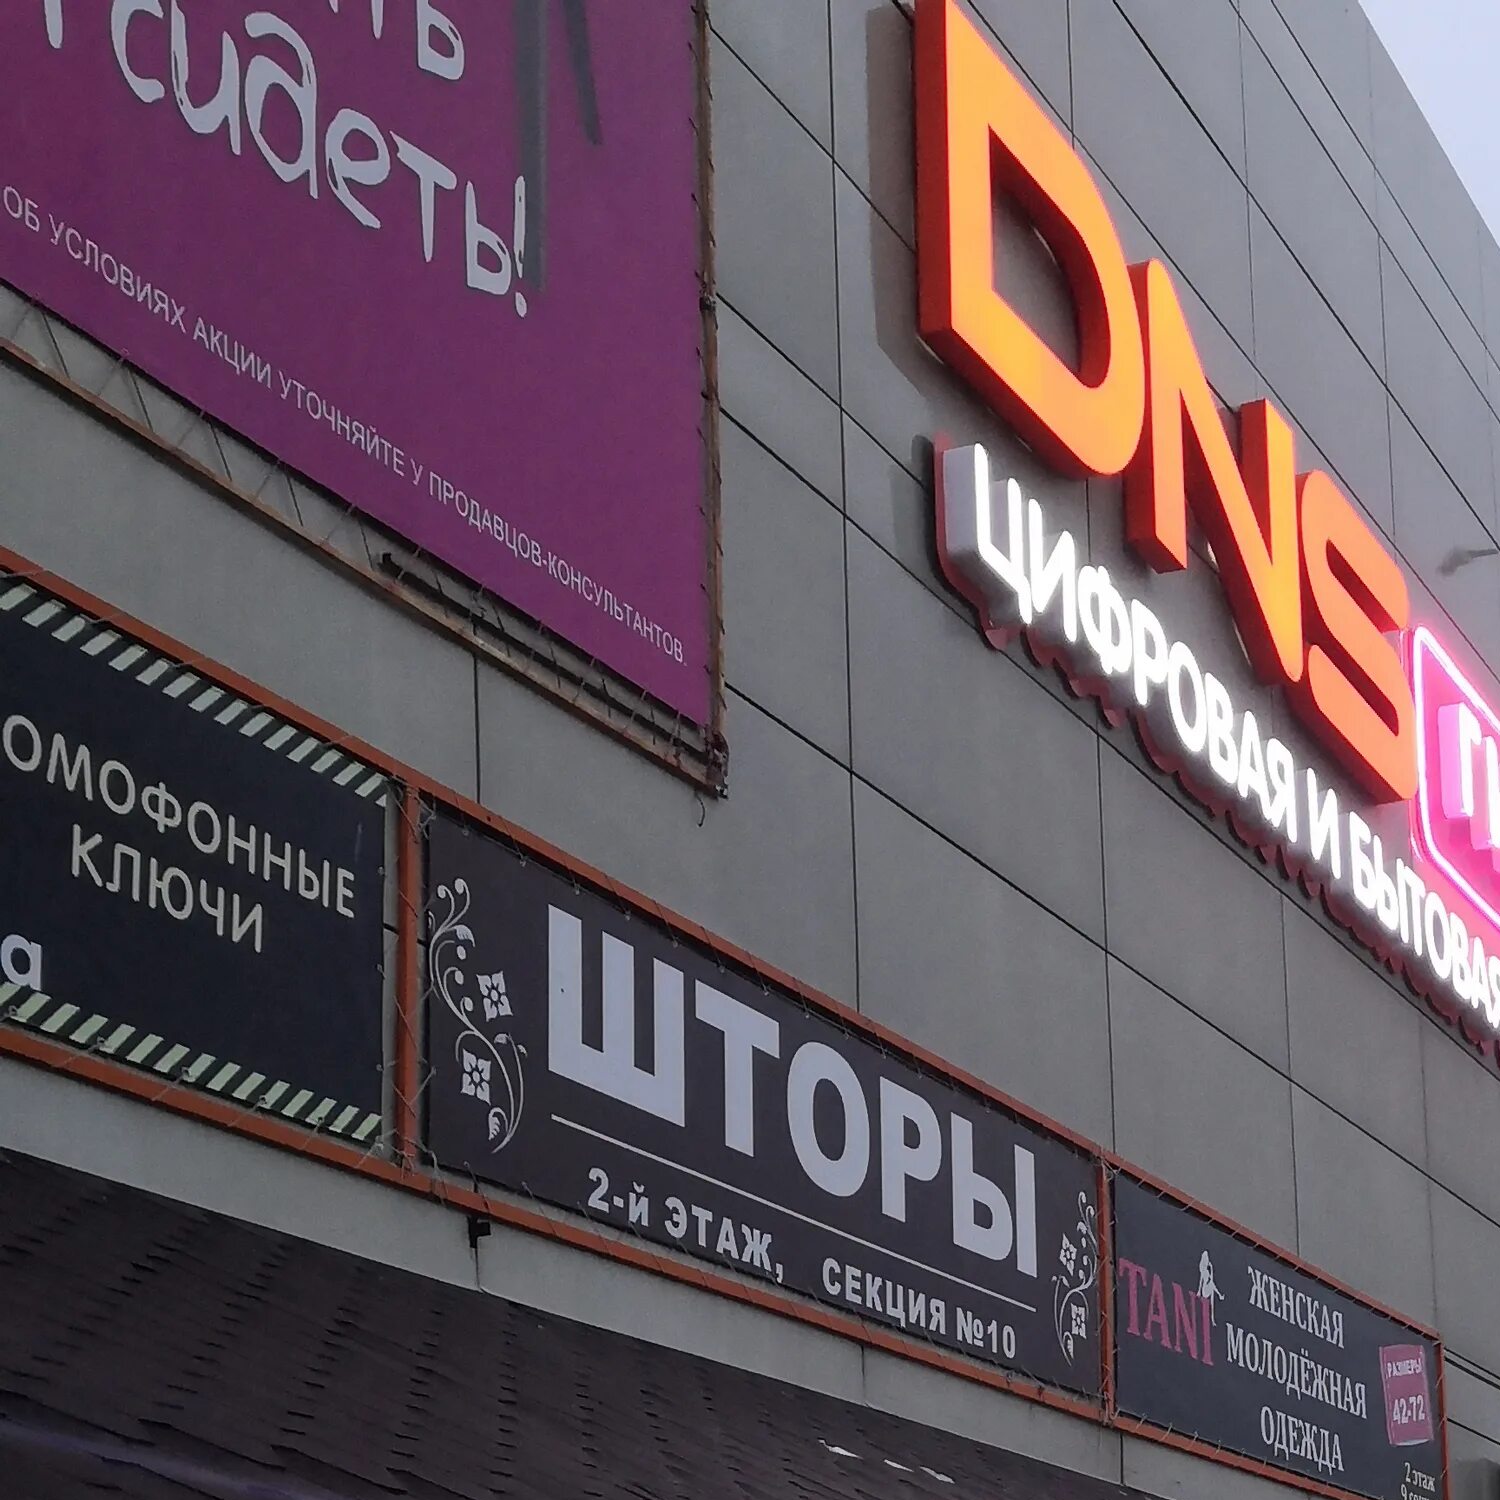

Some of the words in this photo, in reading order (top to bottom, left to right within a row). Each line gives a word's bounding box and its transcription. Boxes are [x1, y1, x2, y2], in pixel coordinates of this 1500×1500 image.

[110, 0, 527, 316] сидеть!
[3, 186, 40, 232] ОБ
[48, 213, 187, 333] УСЛОВИЯХ
[193, 316, 272, 390] АКЦИИ
[278, 370, 405, 477] УТОЧНЯЙТЕ
[409, 461, 424, 486] У
[914, 0, 1418, 799] DNS
[972, 442, 1298, 842] ЦИФРОВАЯ
[1306, 767, 1341, 879] И
[71, 823, 264, 953] КЛЮЧИ
[547, 903, 1038, 1279] ШТОРЫ
[588, 1167, 649, 1227] 2-й
[664, 1196, 783, 1284] ЭТАЖ,
[822, 1257, 946, 1336] СЕКЦИЯ
[956, 1307, 1016, 1359] №10
[1119, 1257, 1214, 1366] TANI
[1248, 1266, 1345, 1349] ЖЕНСКАЯ
[1226, 1322, 1367, 1419] МОЛОДЁЖНАЯ
[1386, 1357, 1423, 1378] РАЗМЕРЫ
[1392, 1395, 1425, 1424] 42-72
[1260, 1406, 1344, 1475] ОДЕЖДА
[1404, 1462, 1411, 1483] 2
[1412, 1469, 1436, 1492] этаж
